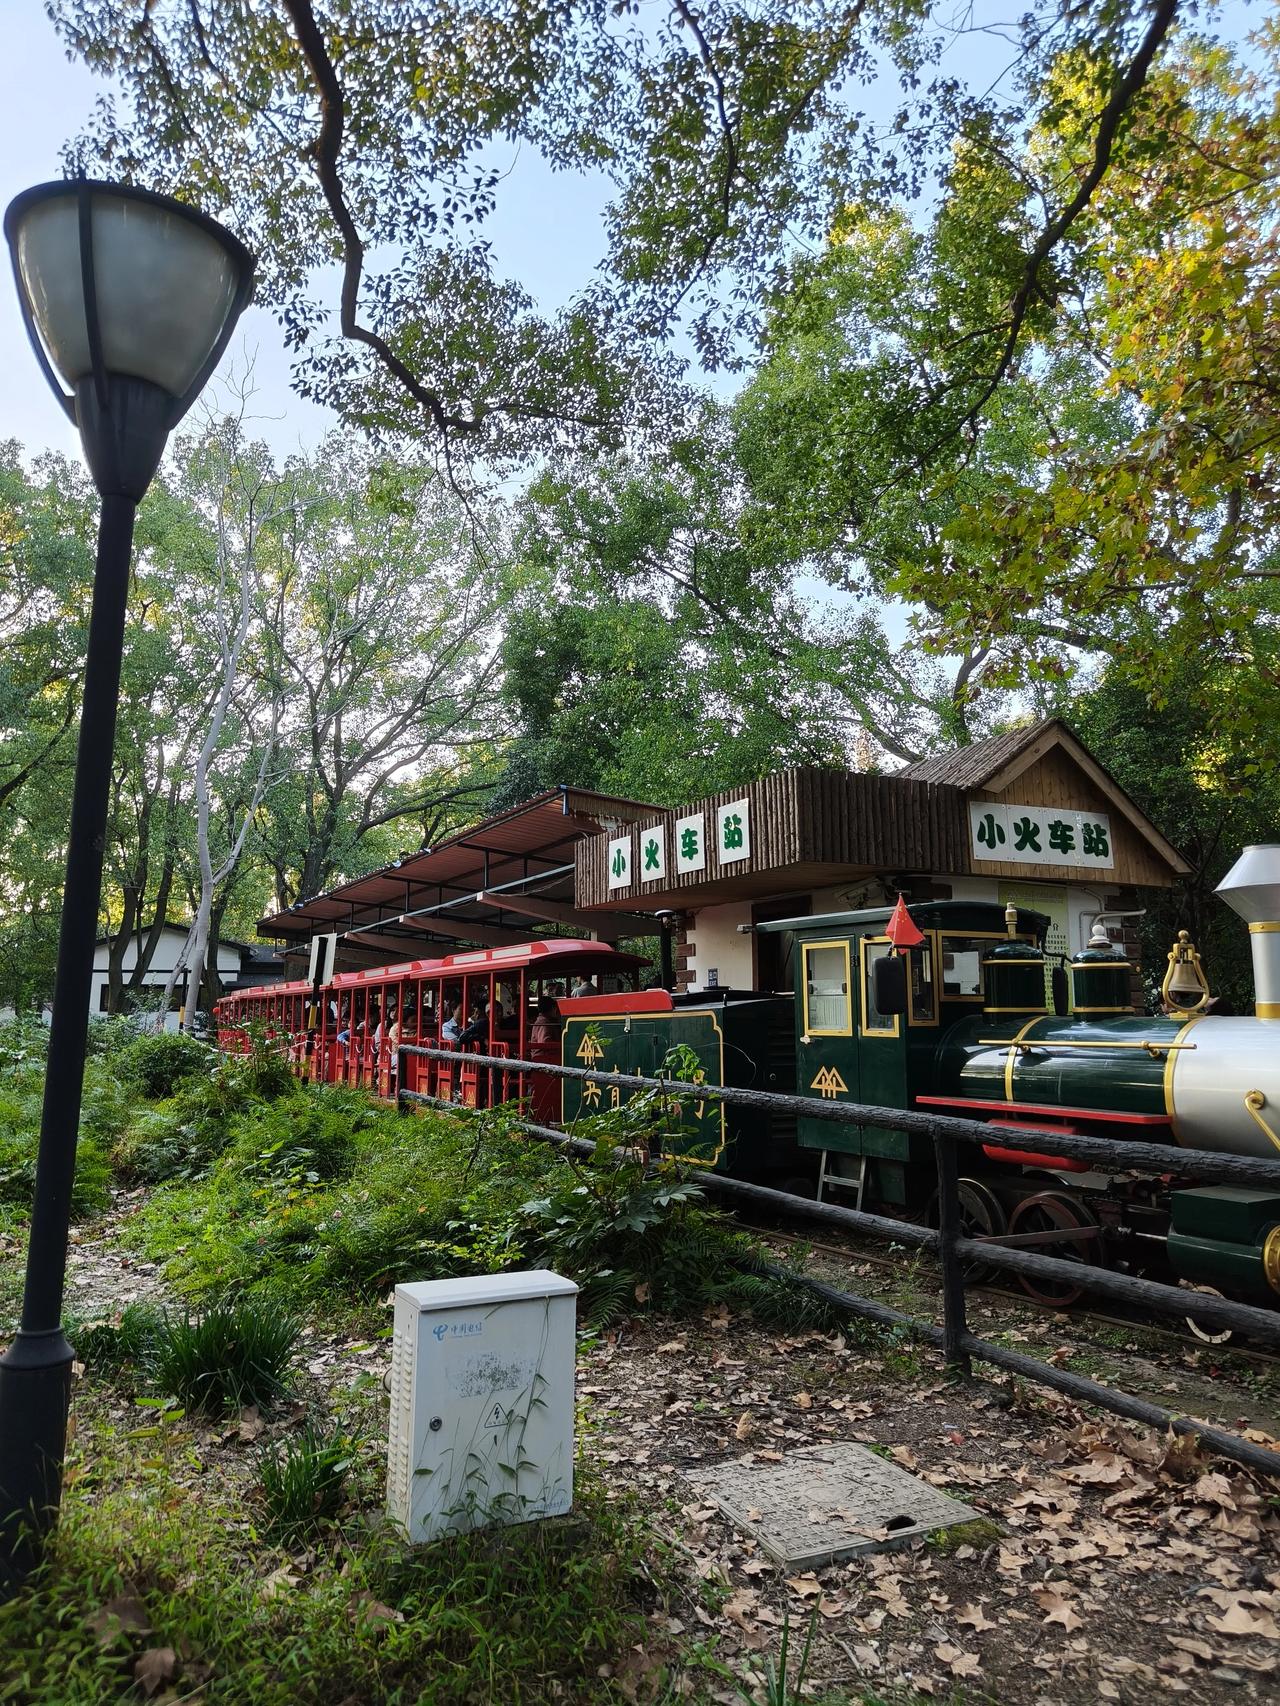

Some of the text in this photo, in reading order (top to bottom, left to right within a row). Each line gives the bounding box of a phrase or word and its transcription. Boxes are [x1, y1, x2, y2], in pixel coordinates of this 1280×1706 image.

[611, 813, 743, 878] 小火车站
[976, 813, 1110, 858] 小火车站
